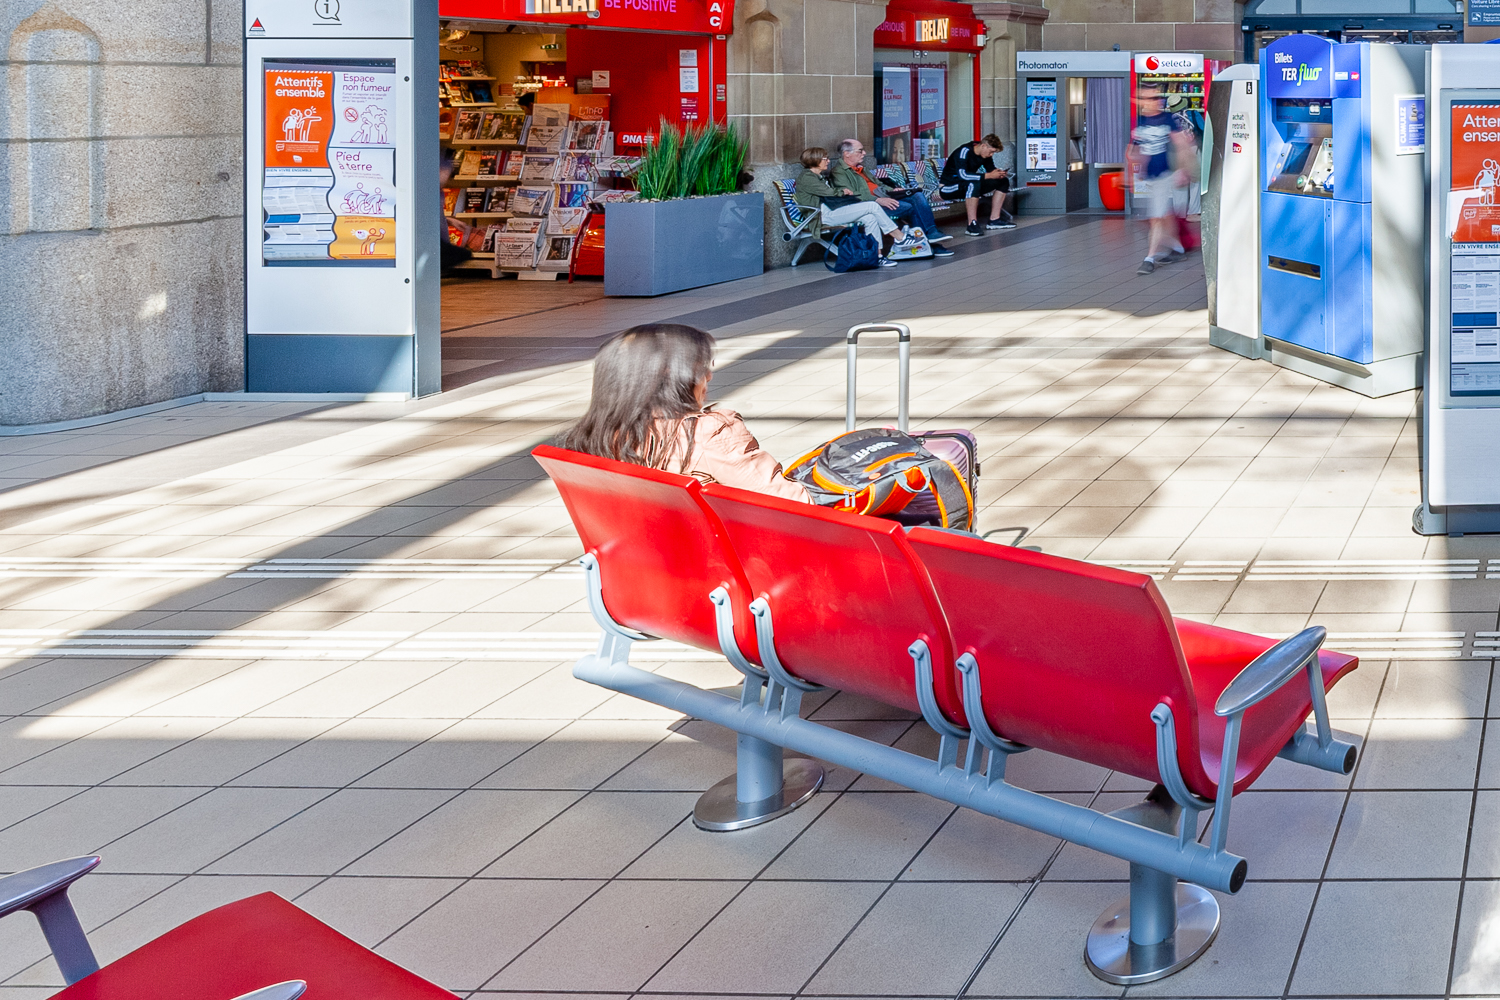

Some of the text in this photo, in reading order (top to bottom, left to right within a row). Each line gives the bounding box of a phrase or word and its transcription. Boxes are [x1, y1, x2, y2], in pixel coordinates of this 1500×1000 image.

[922, 18, 949, 42] RELAY
[951, 28, 970, 37] BE FUN
[1275, 53, 1292, 63] Billets
[343, 74, 375, 84] Espace
[1282, 68, 1297, 81] TER
[275, 76, 323, 87] Attentifs
[276, 88, 325, 97] ensemble
[361, 83, 391, 92] fumeur
[623, 134, 642, 144] DNA
[1232, 131, 1249, 140] échange
[336, 151, 360, 161] Pied
[346, 163, 372, 171] terre
